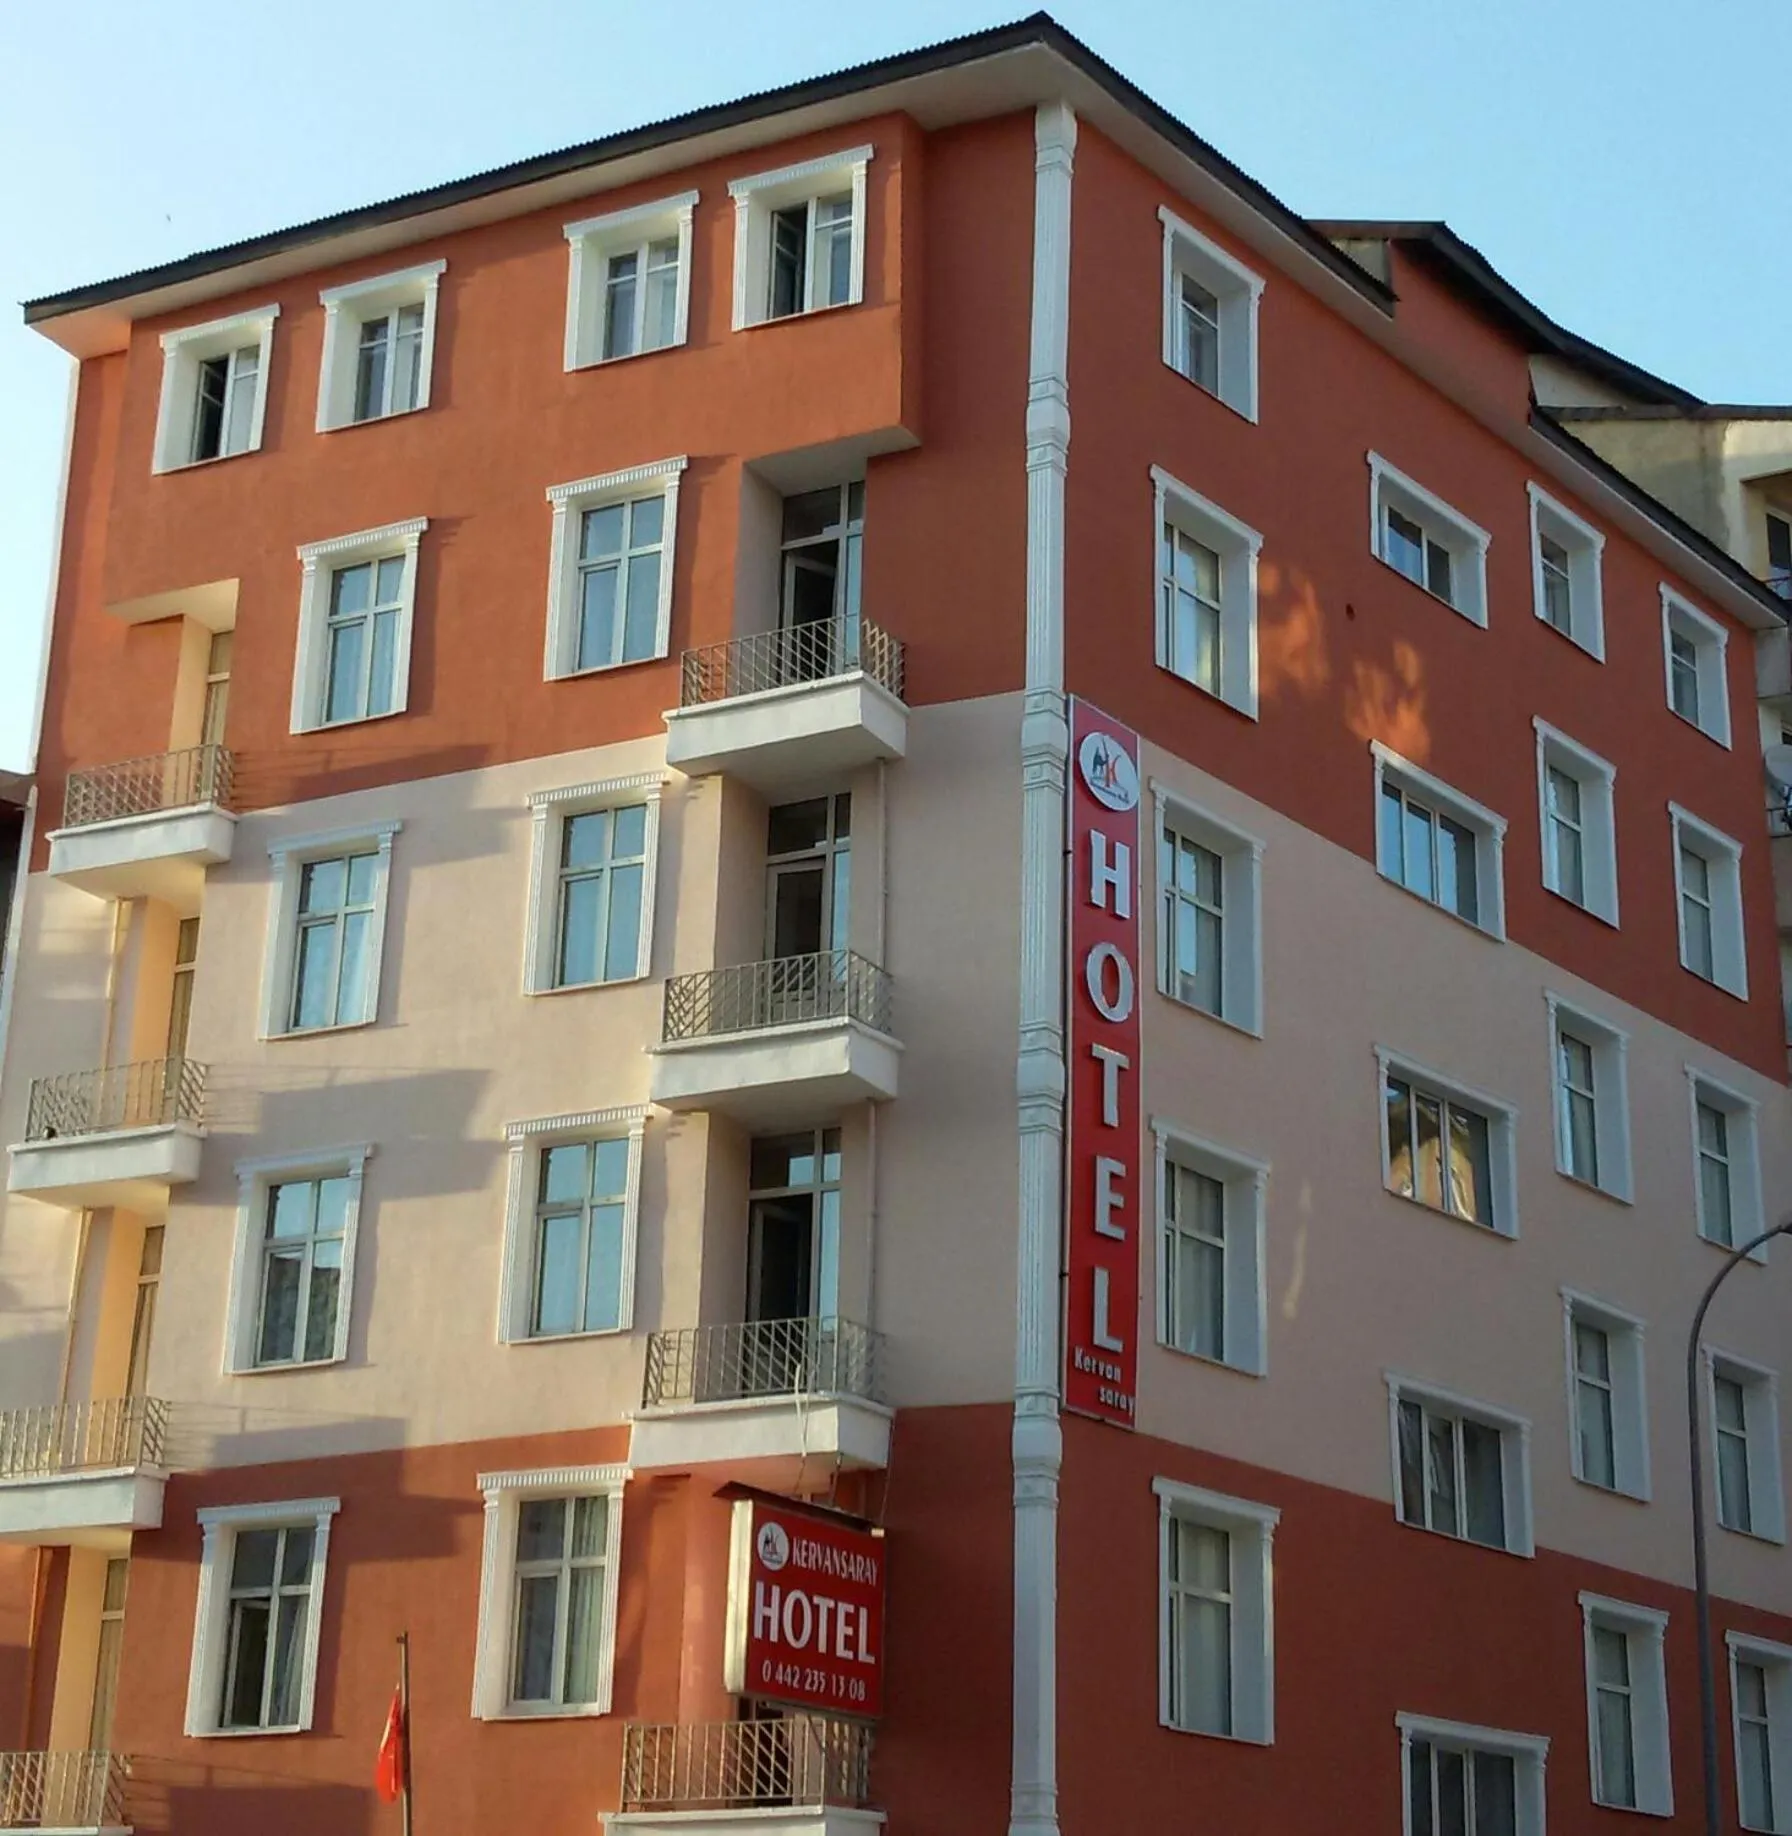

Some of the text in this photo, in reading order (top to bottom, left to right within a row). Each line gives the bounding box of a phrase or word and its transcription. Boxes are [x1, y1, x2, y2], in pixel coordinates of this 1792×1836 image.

[1086, 829, 1134, 1353] HOTEL
[1075, 1344, 1121, 1385] Kervan
[1099, 1386, 1136, 1417] saray
[792, 1536, 879, 1588] KERVANSARAY
[753, 1580, 876, 1665] HOTEL
[762, 1659, 772, 1683] 0
[775, 1662, 800, 1689] 442
[804, 1667, 826, 1694] 235
[849, 1677, 866, 1702] 08
